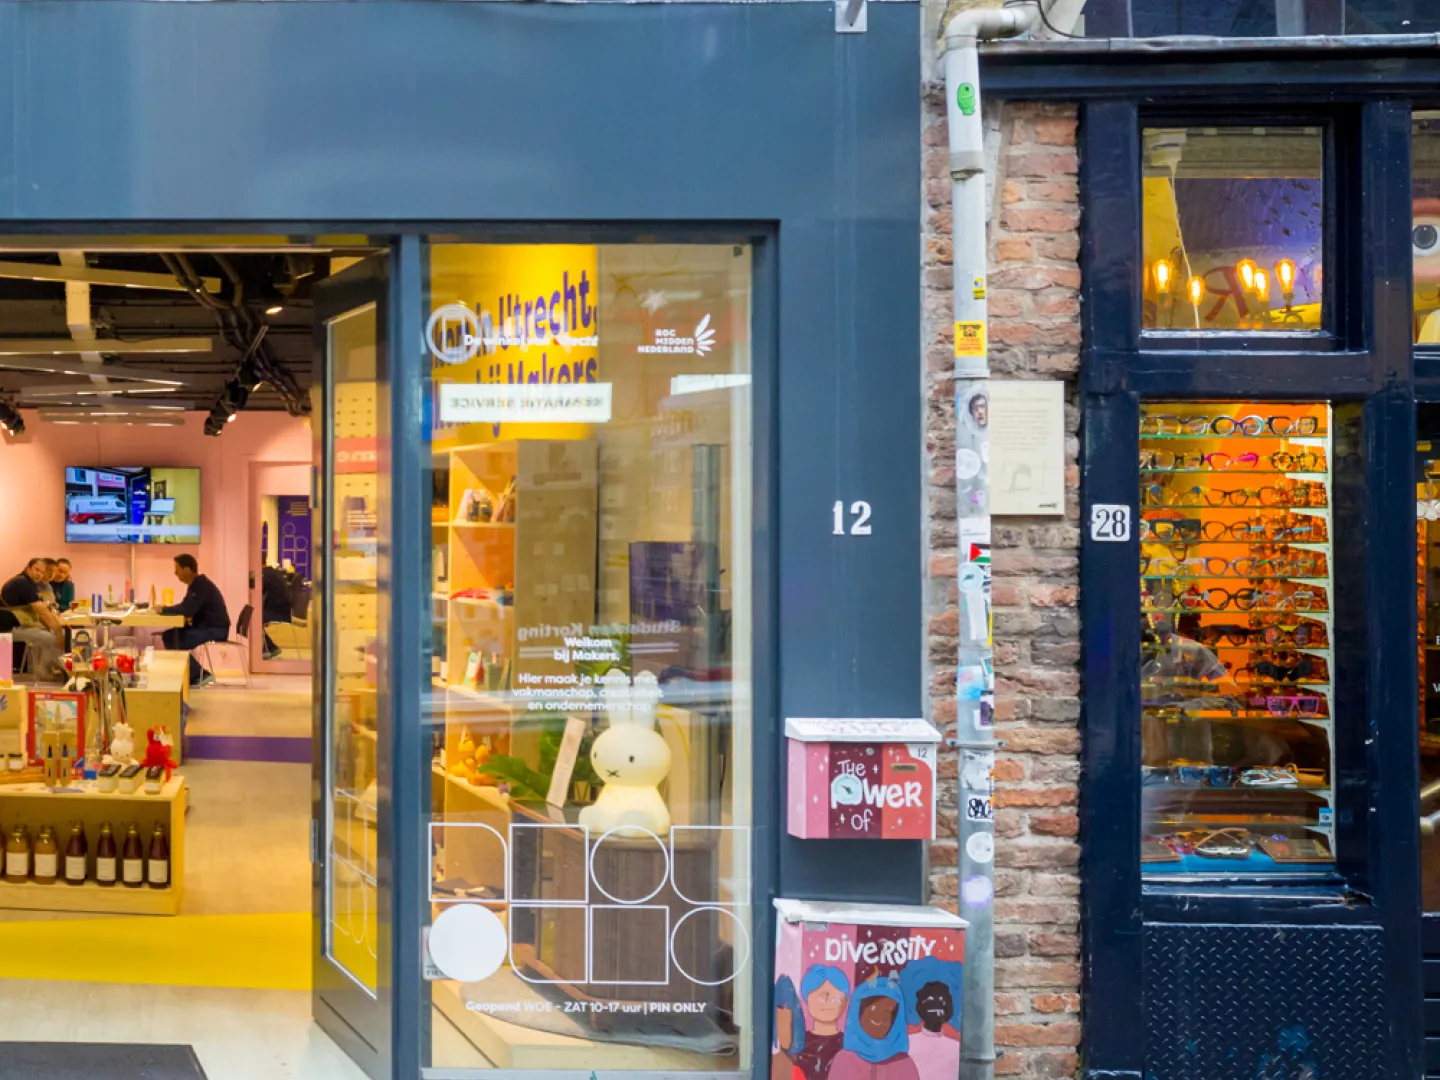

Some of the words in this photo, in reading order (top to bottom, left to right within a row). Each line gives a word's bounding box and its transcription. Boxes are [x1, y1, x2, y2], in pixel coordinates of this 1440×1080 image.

[655, 329, 676, 337] ROC
[655, 337, 694, 345] MIDDEN
[637, 345, 694, 353] NEDERLAND
[832, 500, 872, 535] 12
[1096, 508, 1126, 538] 28
[563, 636, 613, 648] Welkom
[553, 648, 570, 663] bij
[518, 673, 542, 684] Hier
[544, 673, 578, 685] maak
[579, 674, 592, 687] je
[594, 673, 631, 685] kennis
[633, 675, 658, 685] met
[527, 702, 543, 711] en
[545, 700, 652, 713] ondernemerschap
[917, 748, 928, 758] 12
[466, 1001, 521, 1014] Geopend
[523, 1001, 552, 1012] WOE
[563, 1001, 587, 1013] ZAT
[589, 1001, 620, 1013] 10-17
[621, 1003, 642, 1013] uur
[650, 1002, 671, 1013] PIN
[673, 1002, 707, 1013] ONLY
